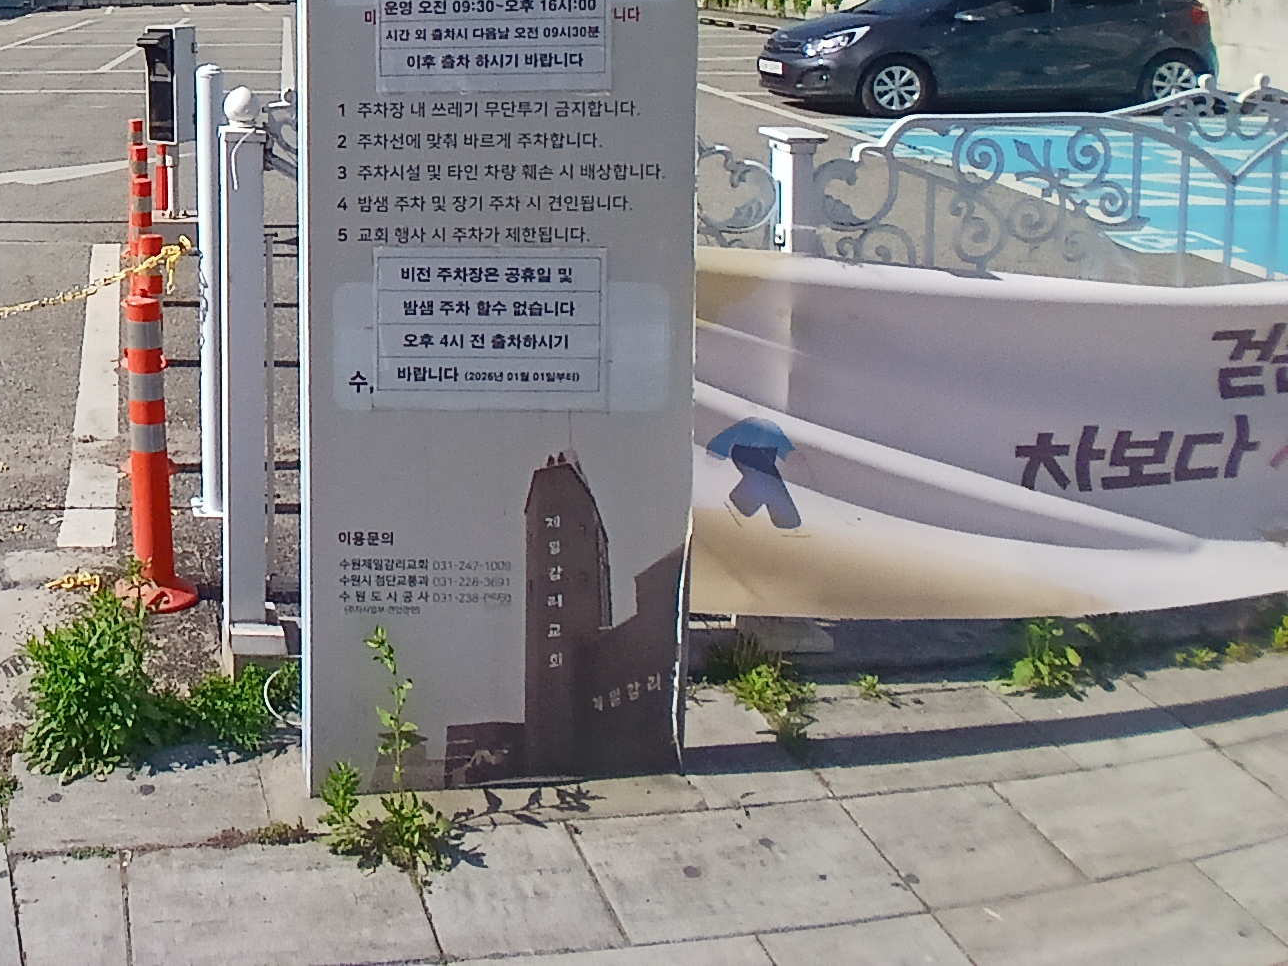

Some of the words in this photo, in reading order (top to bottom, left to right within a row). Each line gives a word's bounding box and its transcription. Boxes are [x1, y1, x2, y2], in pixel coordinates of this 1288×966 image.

[384, 1, 412, 15] 운영
[418, 0, 446, 14] 오전
[386, 29, 410, 41] 시간
[415, 29, 426, 41] 외
[431, 28, 468, 40] 출차시
[473, 27, 509, 40] 다음날
[514, 27, 538, 39] 오전
[543, 26, 600, 38] 09시30분
[407, 55, 436, 69] 이후
[441, 54, 470, 69] 출차
[476, 54, 518, 68] 하시기
[525, 53, 583, 68] 바랍니다
[338, 104, 344, 117] 1
[358, 102, 404, 119] 주차장
[411, 102, 425, 118] 내
[432, 102, 478, 117] 쓰레기
[485, 101, 547, 118] 무단투기
[555, 101, 640, 117] 금지합니다.
[338, 135, 346, 148] 2
[358, 133, 420, 150] 주차선에
[427, 133, 457, 149] 맞춰
[464, 132, 510, 149] 바르게
[517, 132, 602, 149] 주차합니다.
[338, 166, 346, 179] 3
[358, 165, 420, 181] 주차시설
[427, 165, 440, 180] 및
[448, 165, 477, 180] 타인
[484, 165, 516, 181] 차량
[522, 164, 554, 180] 훼손
[560, 164, 573, 179] 시
[581, 164, 665, 180] 배상합니다.
[337, 197, 347, 210] 4
[358, 196, 388, 212] 밤샘
[394, 196, 425, 212] 주차
[432, 196, 446, 212] 및
[453, 196, 482, 212] 장기
[489, 196, 520, 211] 주차
[527, 195, 540, 210] 시
[549, 195, 632, 212] 견인됩니다.
[338, 228, 347, 242] 5
[358, 227, 388, 243] 교회
[395, 227, 426, 246] 행사
[432, 227, 445, 242] 시
[453, 227, 500, 243] 주차가
[506, 227, 589, 243] 제한됩니다.
[401, 267, 430, 282] 비전
[437, 267, 499, 283] 주차장은
[505, 267, 551, 283] 공휴일
[558, 268, 572, 283] 및
[404, 300, 433, 315] 밤샘
[440, 301, 470, 316] 주차
[477, 301, 507, 316] 할수
[513, 301, 575, 316] 없습니다
[403, 334, 434, 348] 오후
[440, 334, 463, 348] 4시
[470, 334, 484, 349] 전
[491, 334, 568, 349] 출차하시기
[1212, 322, 1288, 400] 걷
[398, 366, 458, 382] 바랍니다
[465, 372, 503, 382] (2026년
[1015, 414, 1261, 492] 차보다
[339, 532, 393, 546] 이용문의
[339, 559, 428, 571] 수원제일감리교회
[340, 575, 372, 586] 수원시
[433, 593, 511, 603] 031-238-
